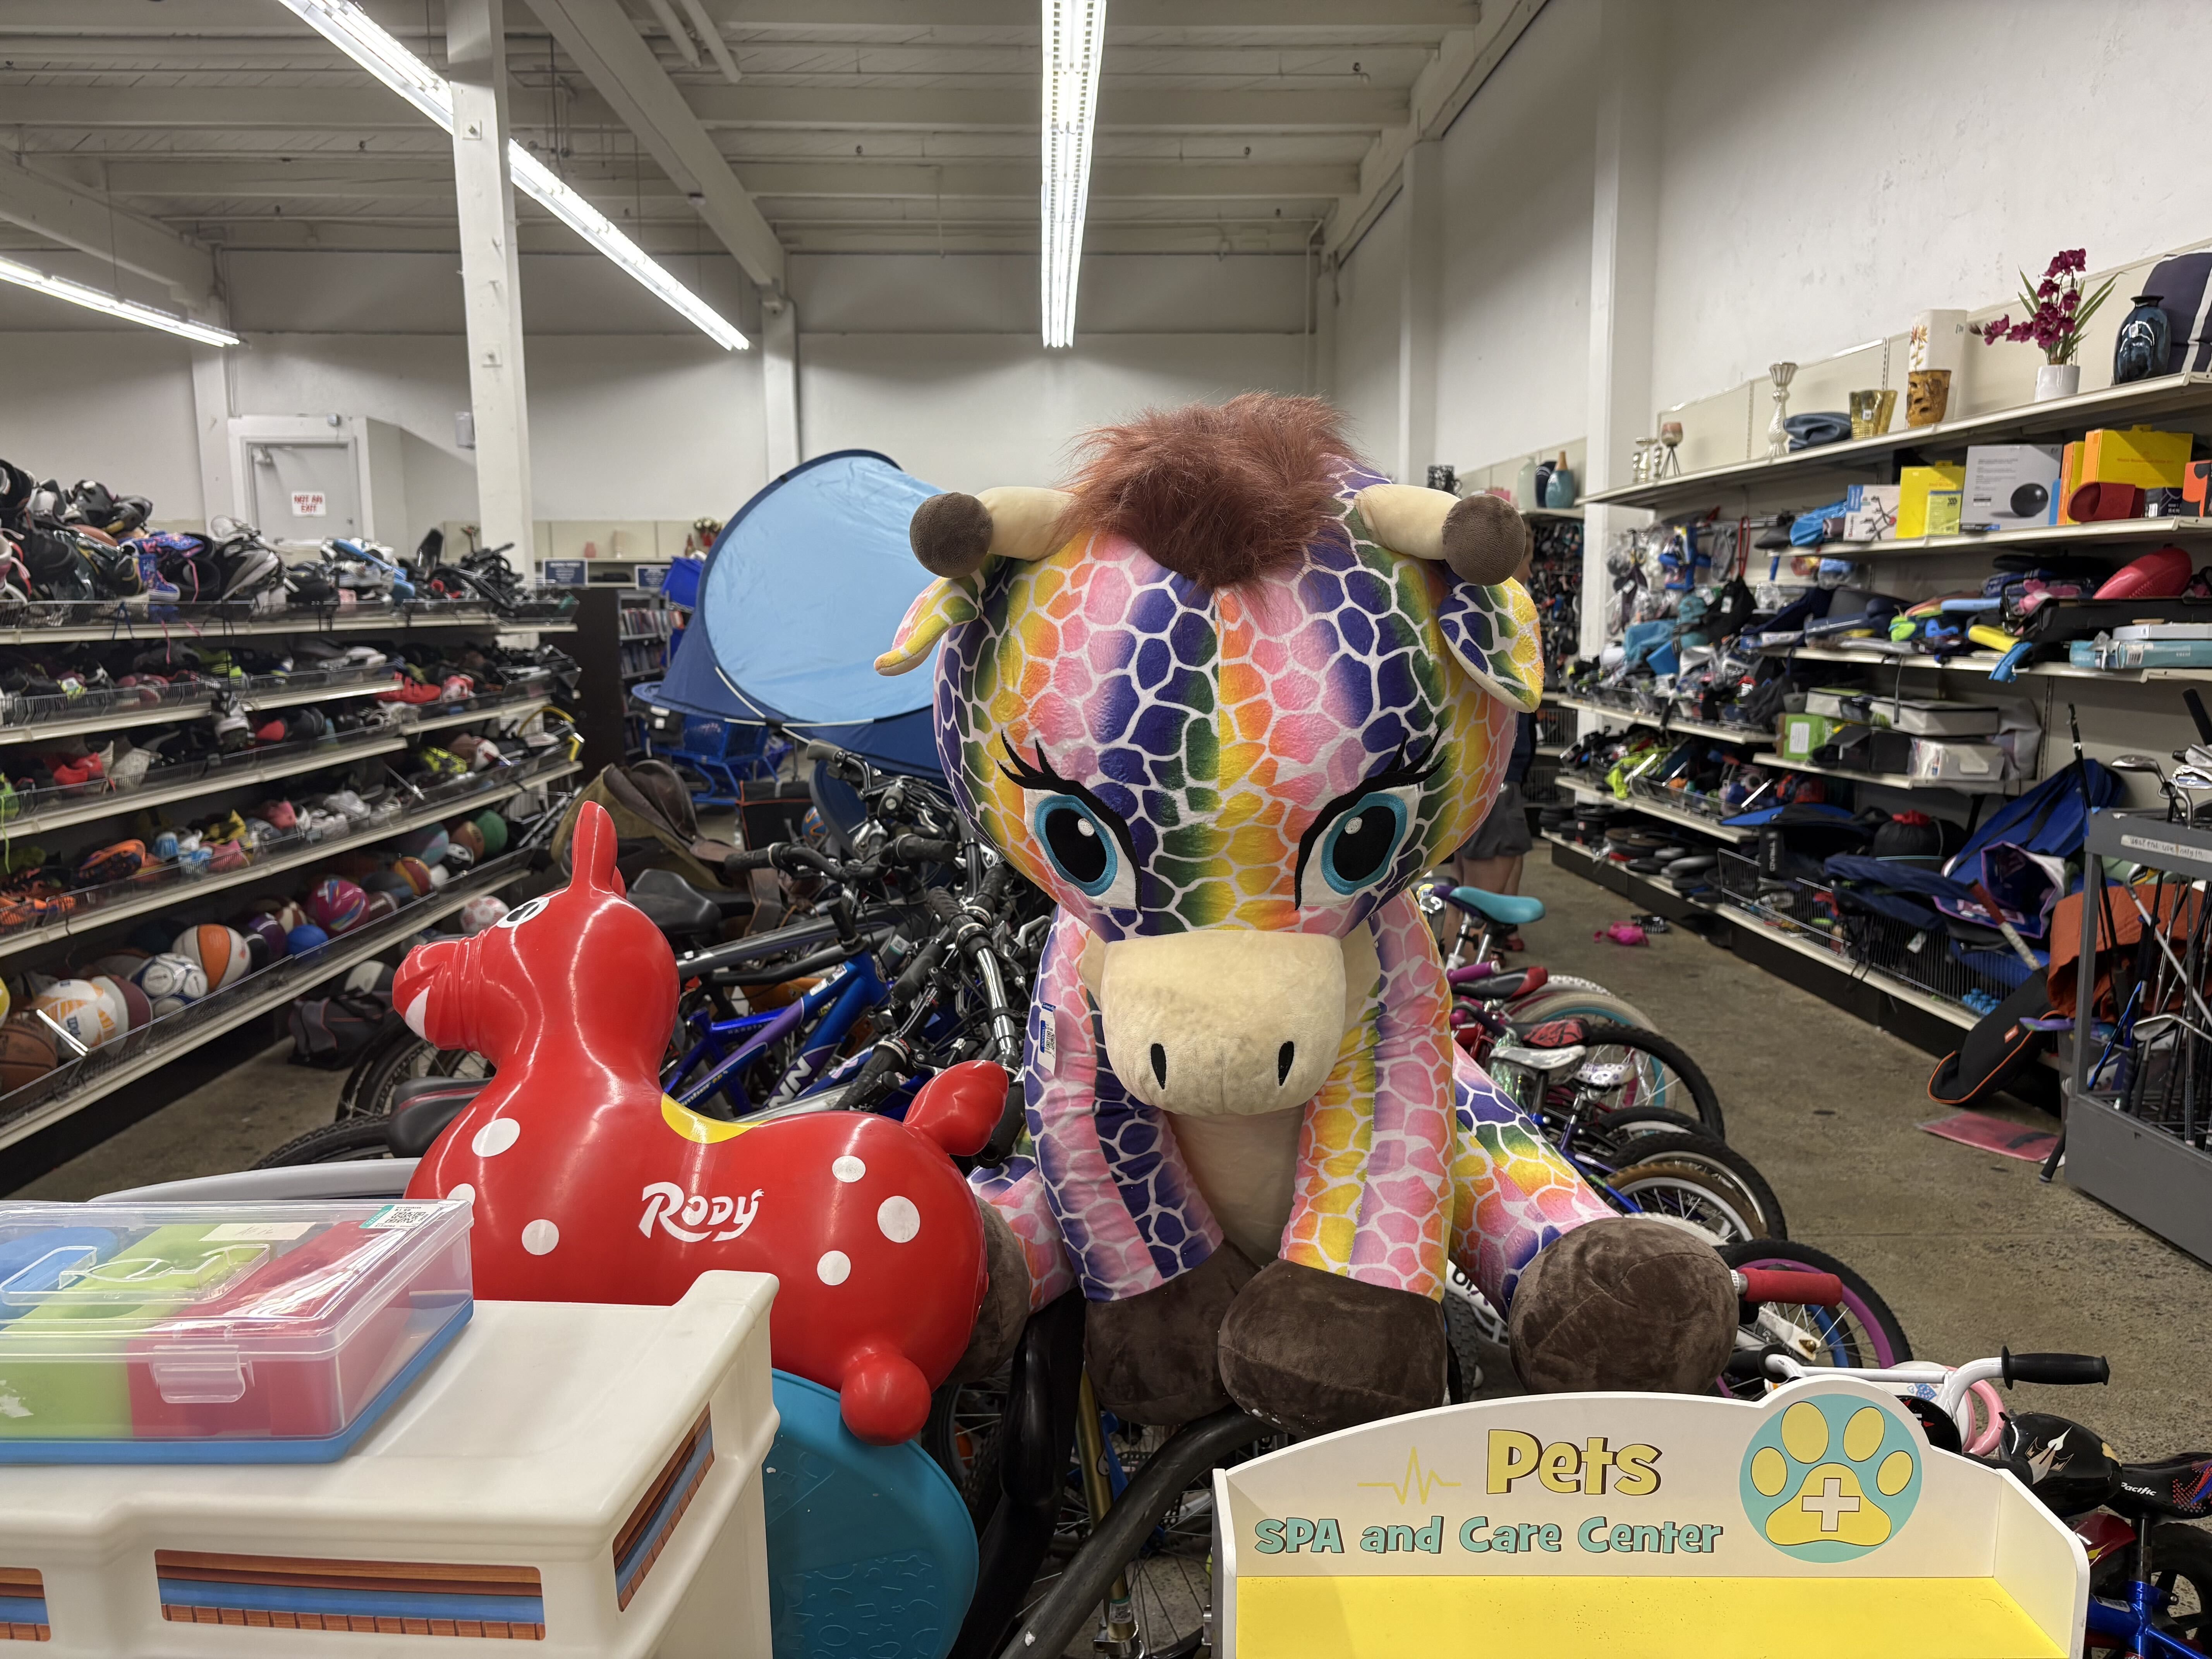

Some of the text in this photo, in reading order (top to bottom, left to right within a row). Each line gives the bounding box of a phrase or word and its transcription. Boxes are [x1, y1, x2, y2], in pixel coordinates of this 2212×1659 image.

[294, 495, 323, 503] NOT AN
[301, 505, 316, 513] EXIT
[1486, 1429, 1663, 1496] Pets
[2121, 1482, 2157, 1496] Pacific
[1254, 1515, 1724, 1554] SPA and Care Center
